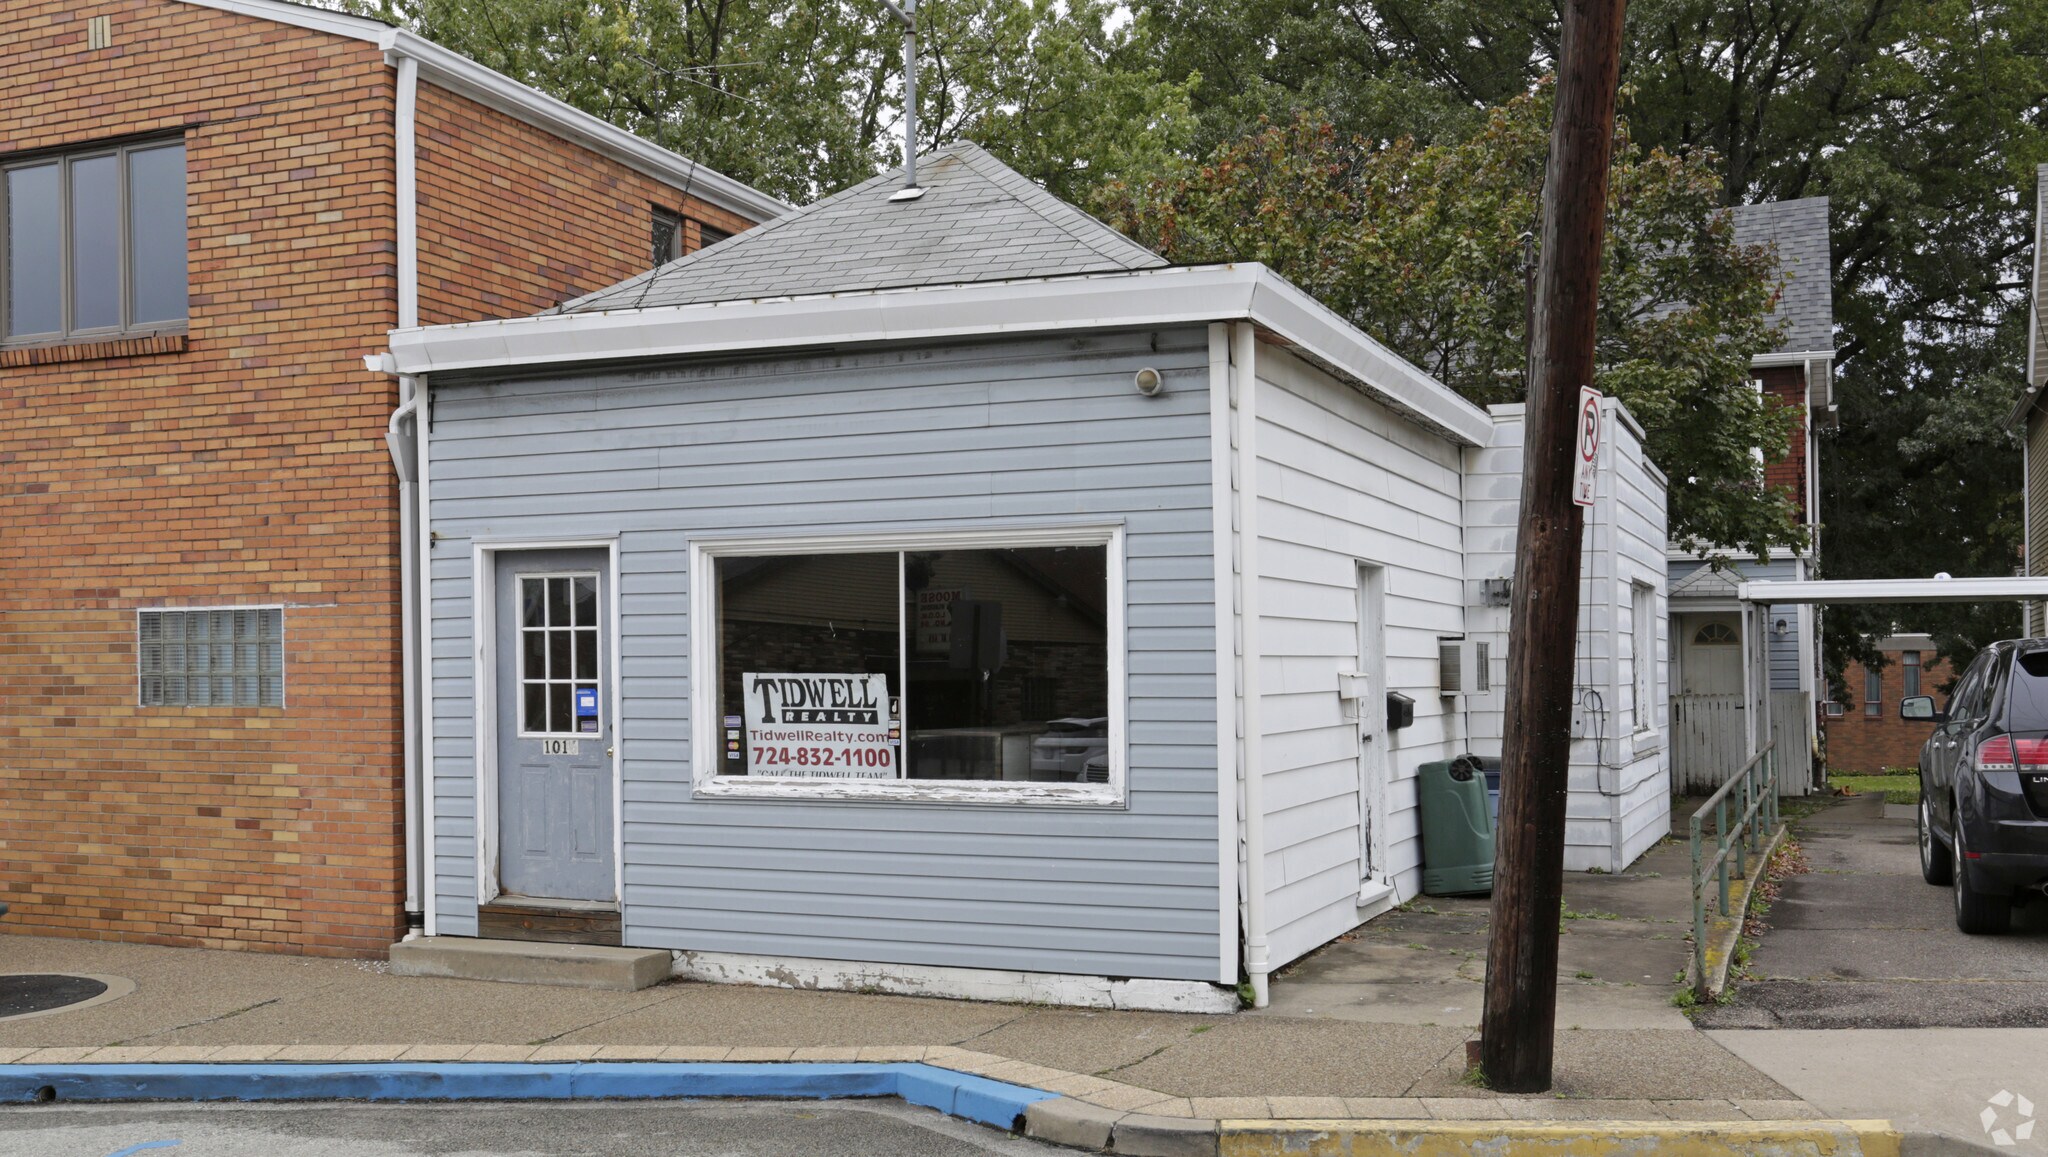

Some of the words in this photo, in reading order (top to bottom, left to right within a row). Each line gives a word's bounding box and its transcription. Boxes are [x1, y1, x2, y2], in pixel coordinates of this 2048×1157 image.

[753, 678, 877, 723] TIDWELL
[785, 711, 873, 723] REALTY
[750, 730, 889, 743] TidwellRealty.com
[752, 747, 891, 767] 724-832-1100
